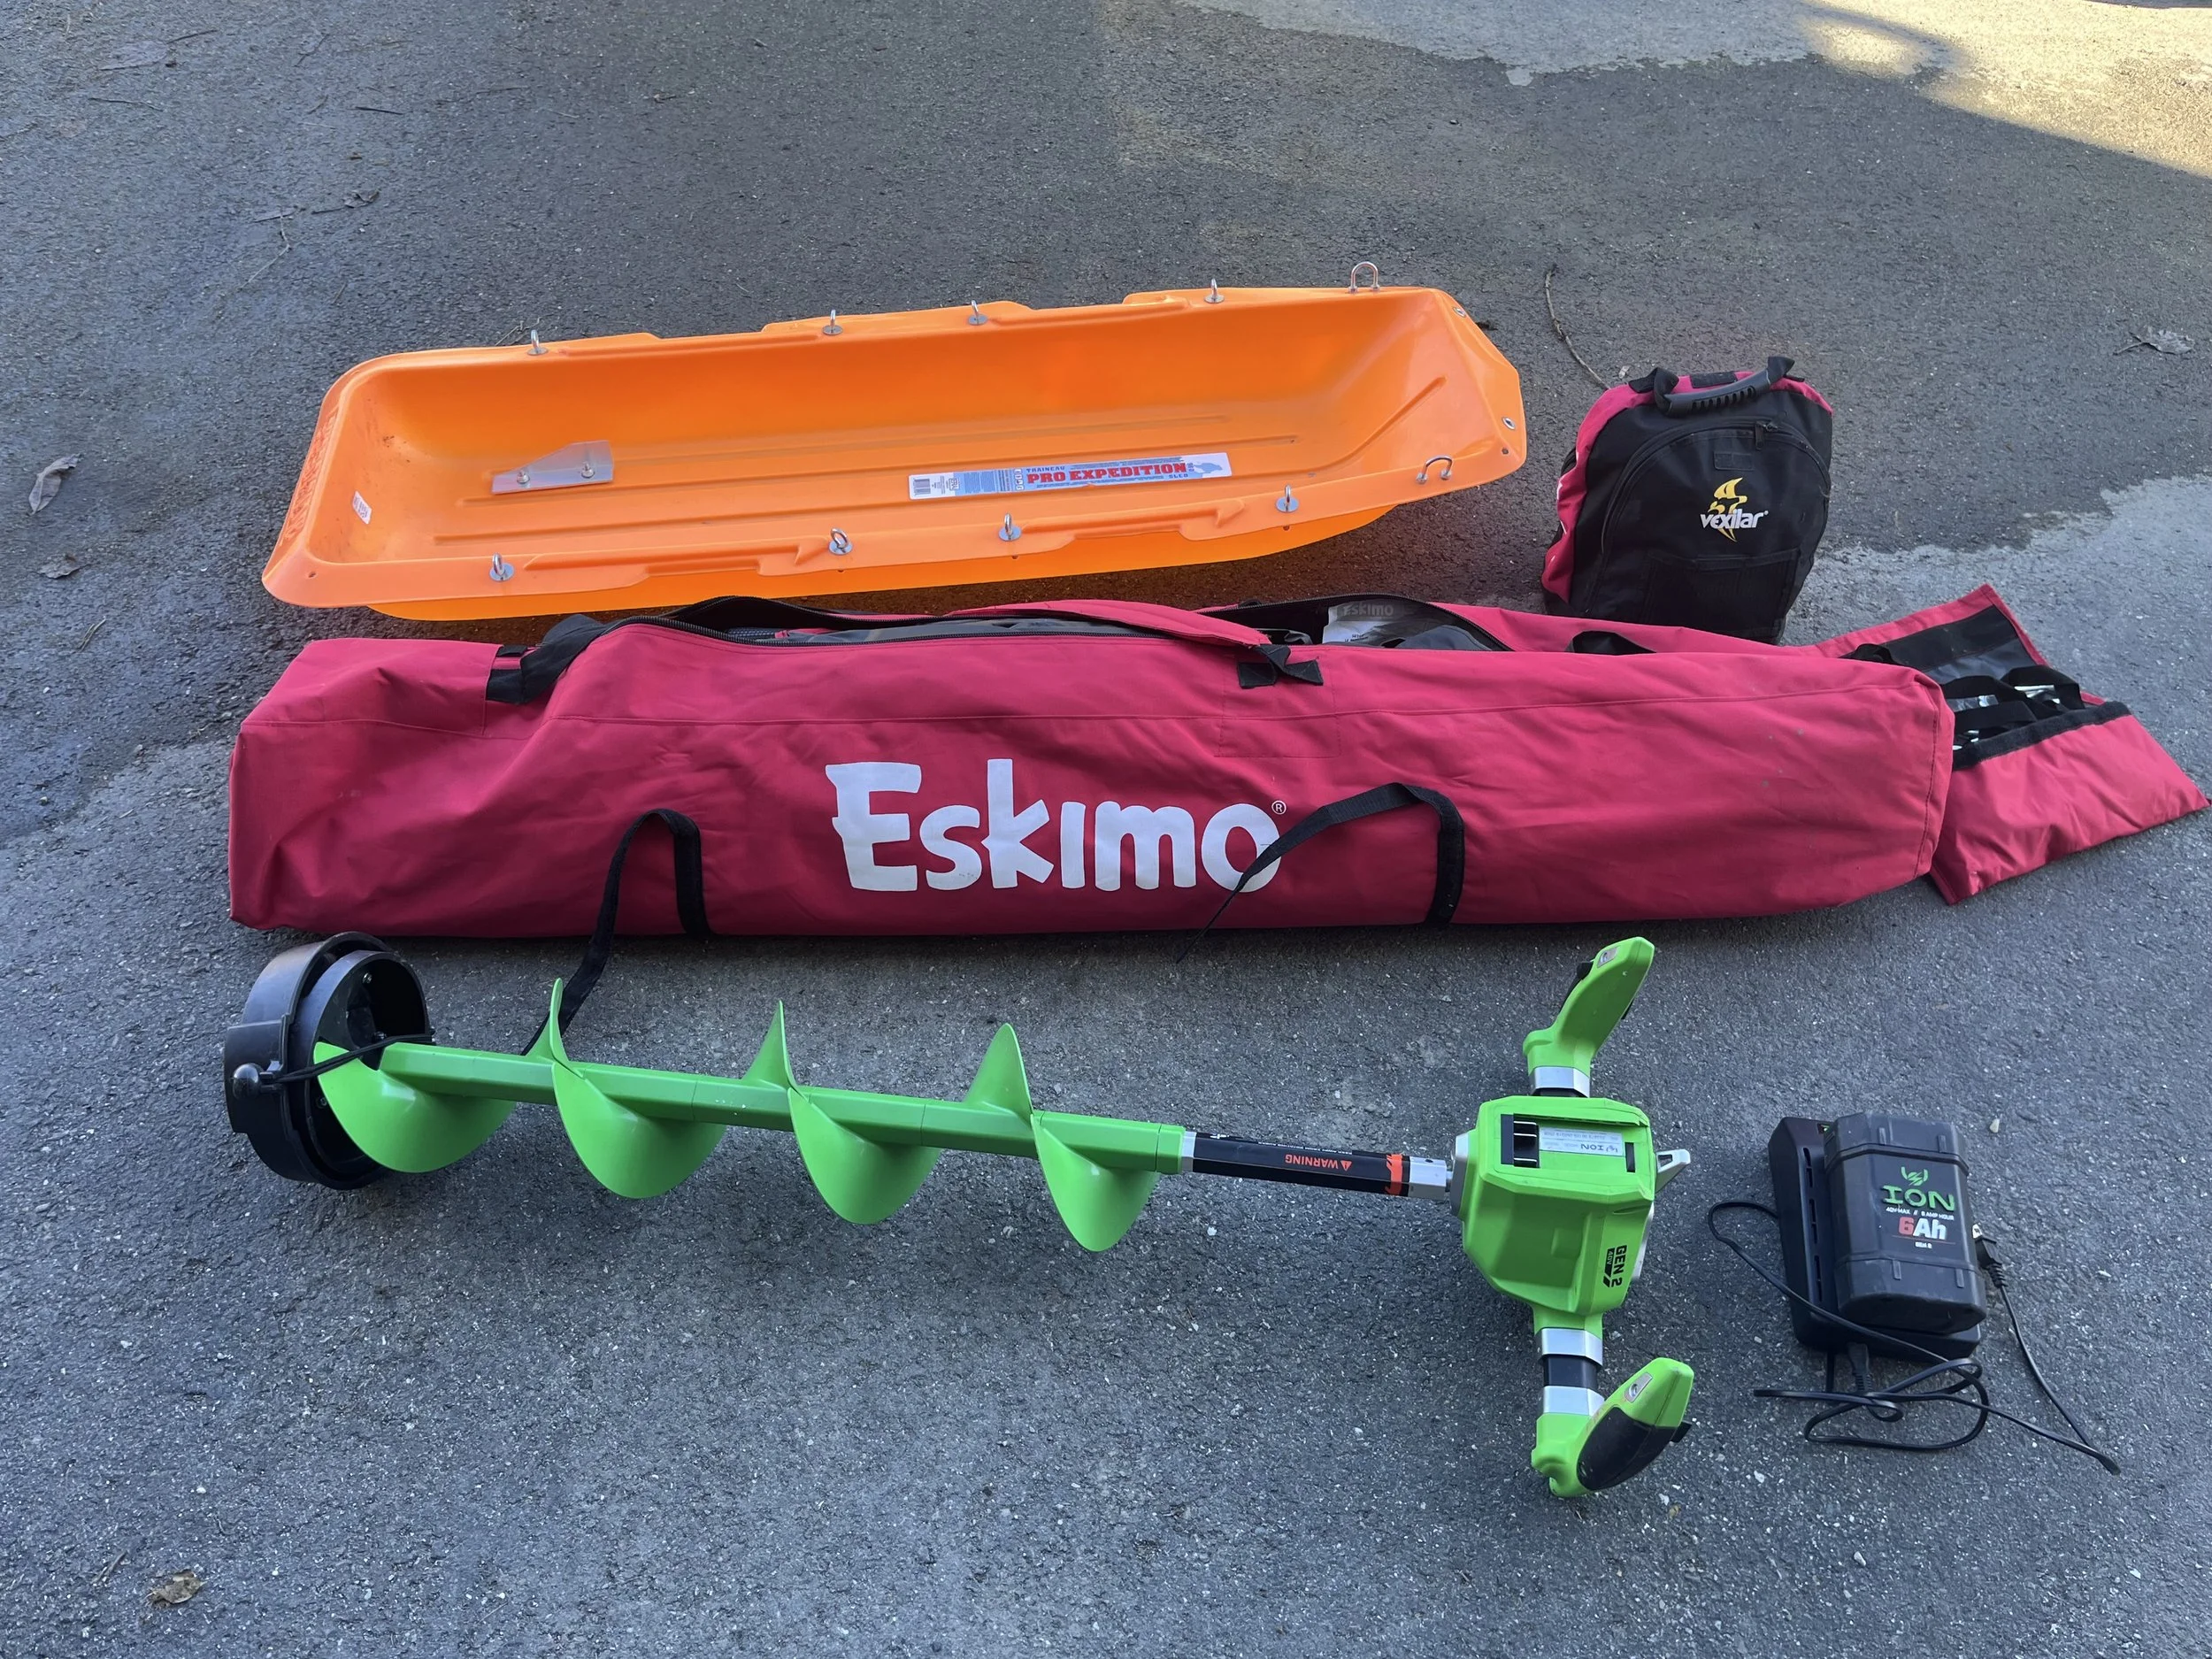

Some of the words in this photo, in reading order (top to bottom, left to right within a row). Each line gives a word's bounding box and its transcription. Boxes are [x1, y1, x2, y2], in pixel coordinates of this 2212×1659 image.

[1026, 471, 1066, 484] PRO
[1069, 462, 1187, 481] EXPEDITION
[825, 758, 1282, 892] Eskimo
[1284, 1154, 1340, 1171] WARNING
[1880, 1185, 1956, 1211] ION
[1898, 1216, 1947, 1240] 6Ah
[1613, 1244, 1628, 1275] GEN
[1610, 1277, 1623, 1288] 2
